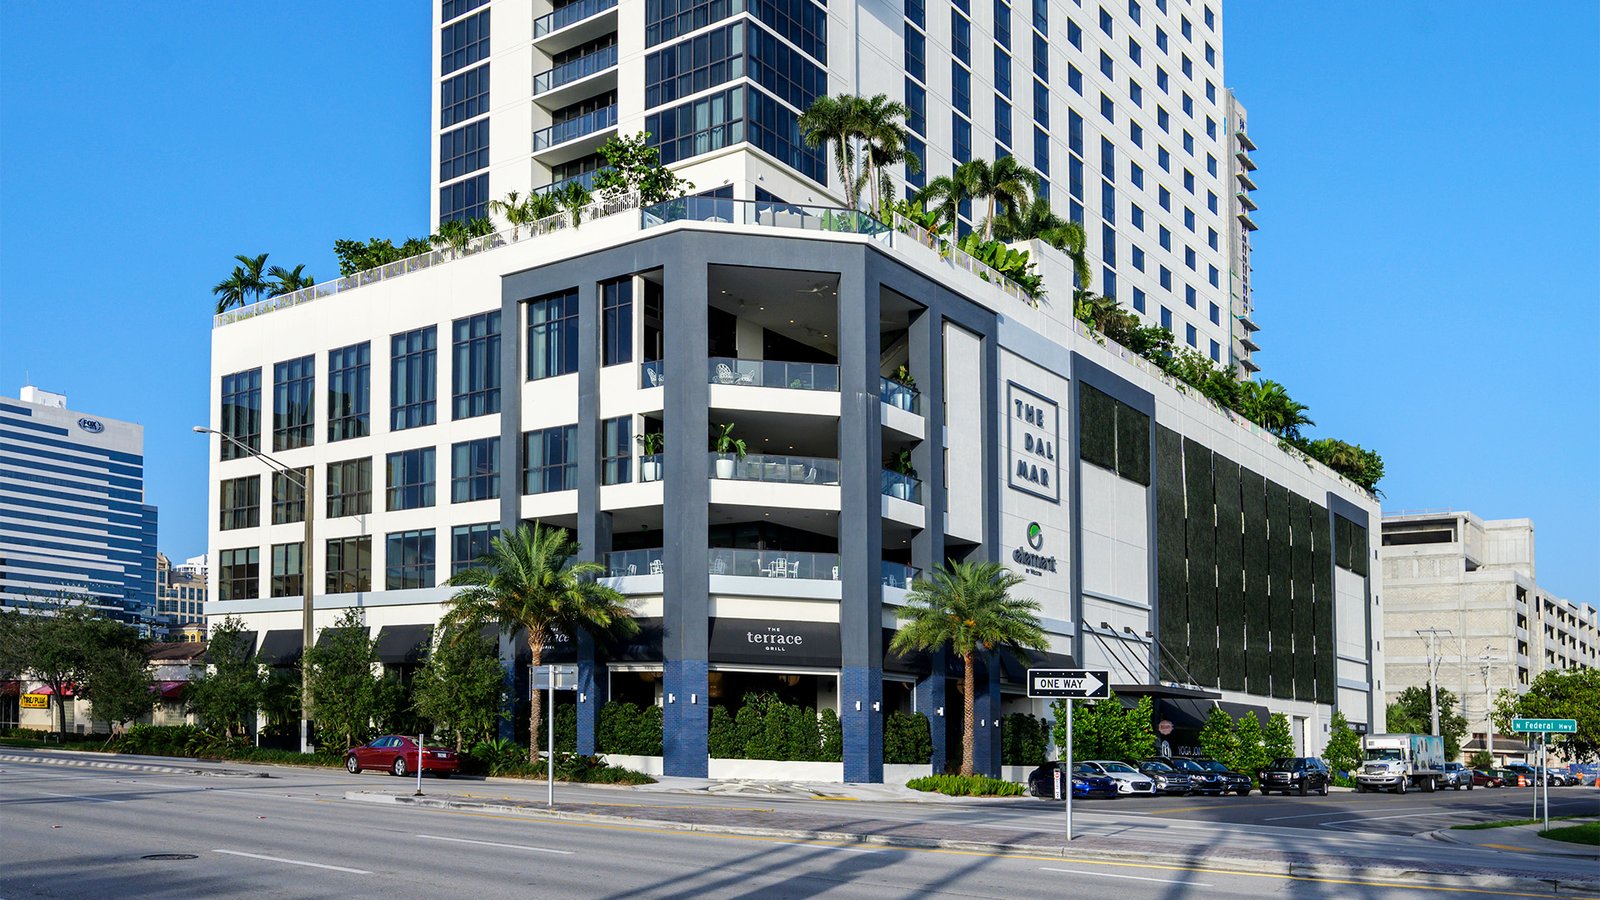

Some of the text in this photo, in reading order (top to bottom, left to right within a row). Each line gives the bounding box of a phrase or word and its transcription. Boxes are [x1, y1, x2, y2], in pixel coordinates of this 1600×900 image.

[1014, 399, 1044, 428] THE
[83, 419, 97, 428] FOX
[1024, 433, 1054, 461] DAL
[1016, 459, 1049, 488] MAR
[746, 631, 803, 645] terrace
[1040, 679, 1084, 688] ONE WAY
[1525, 721, 1554, 730] Federal
[1558, 723, 1573, 731] Hwy
[1177, 745, 1191, 756] YOGA
